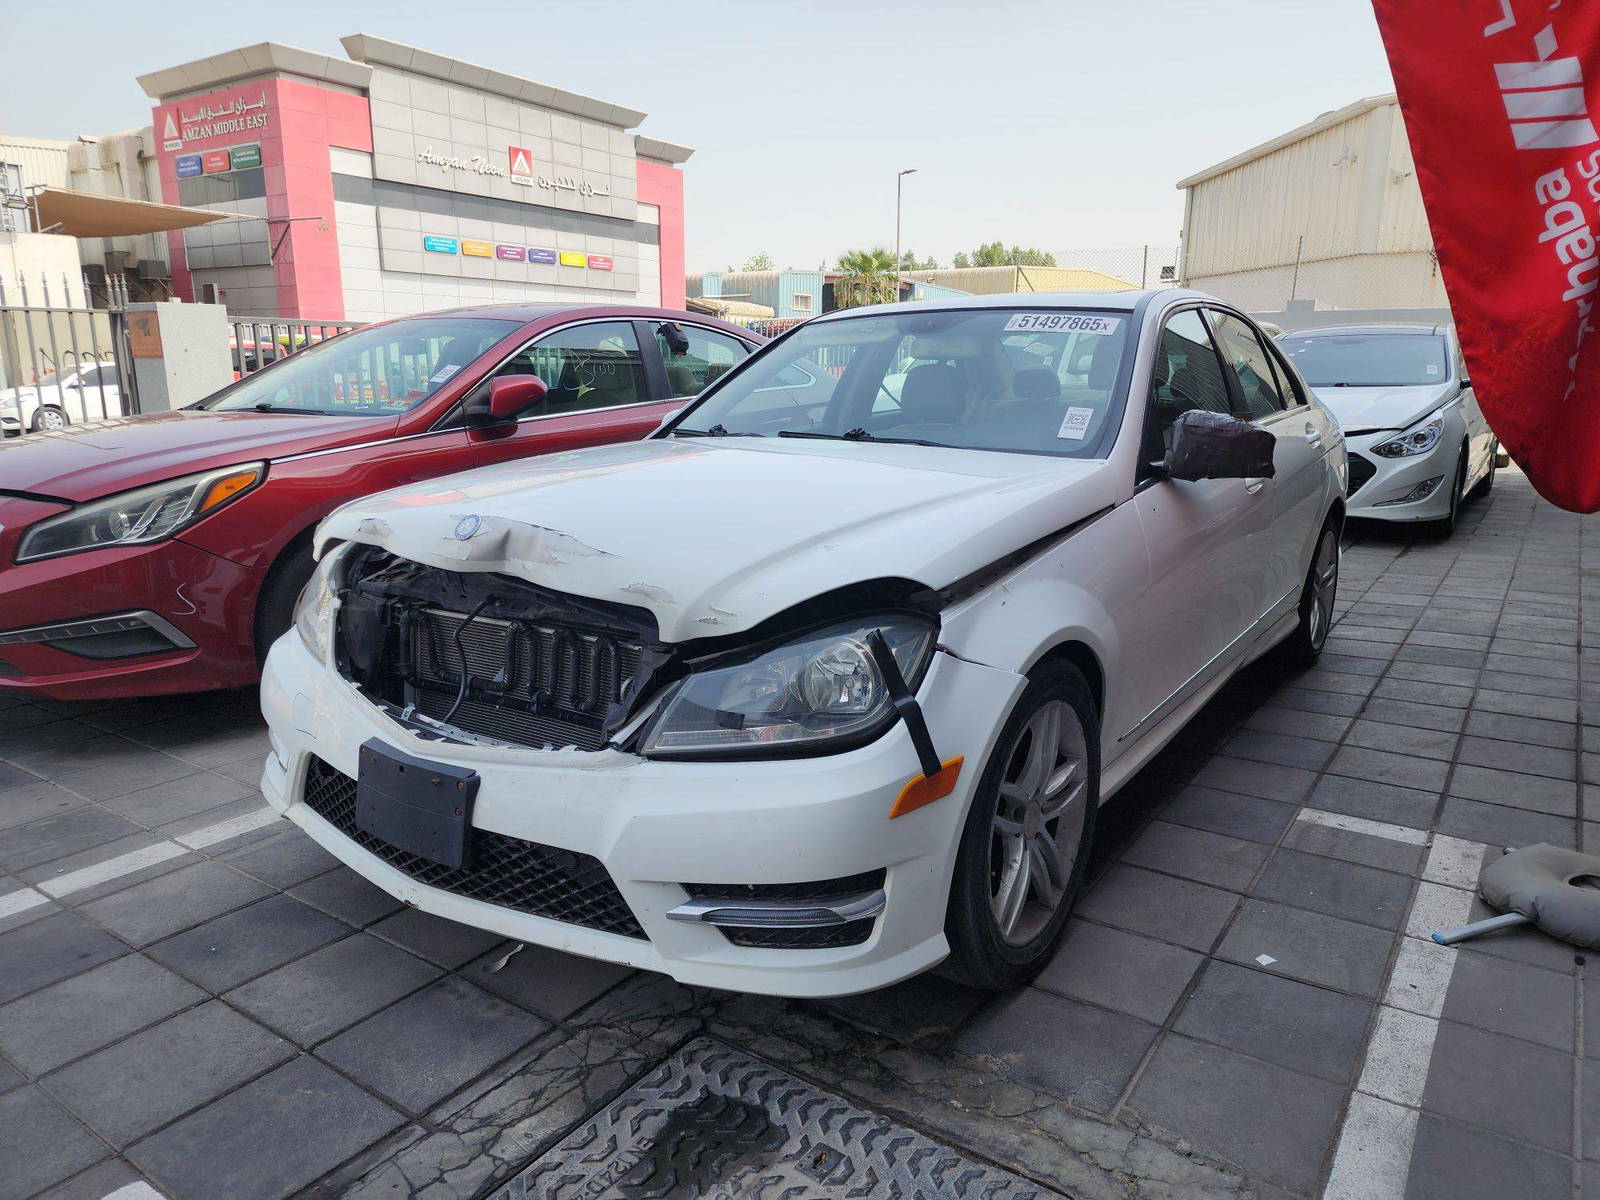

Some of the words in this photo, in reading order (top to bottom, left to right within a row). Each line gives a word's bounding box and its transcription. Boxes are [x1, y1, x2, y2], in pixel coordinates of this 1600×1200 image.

[182, 123, 212, 143] AMZAN
[213, 117, 245, 137] MIDDLE
[248, 112, 268, 129] EAST
[416, 145, 467, 172] Amzan
[471, 155, 505, 177] Neon
